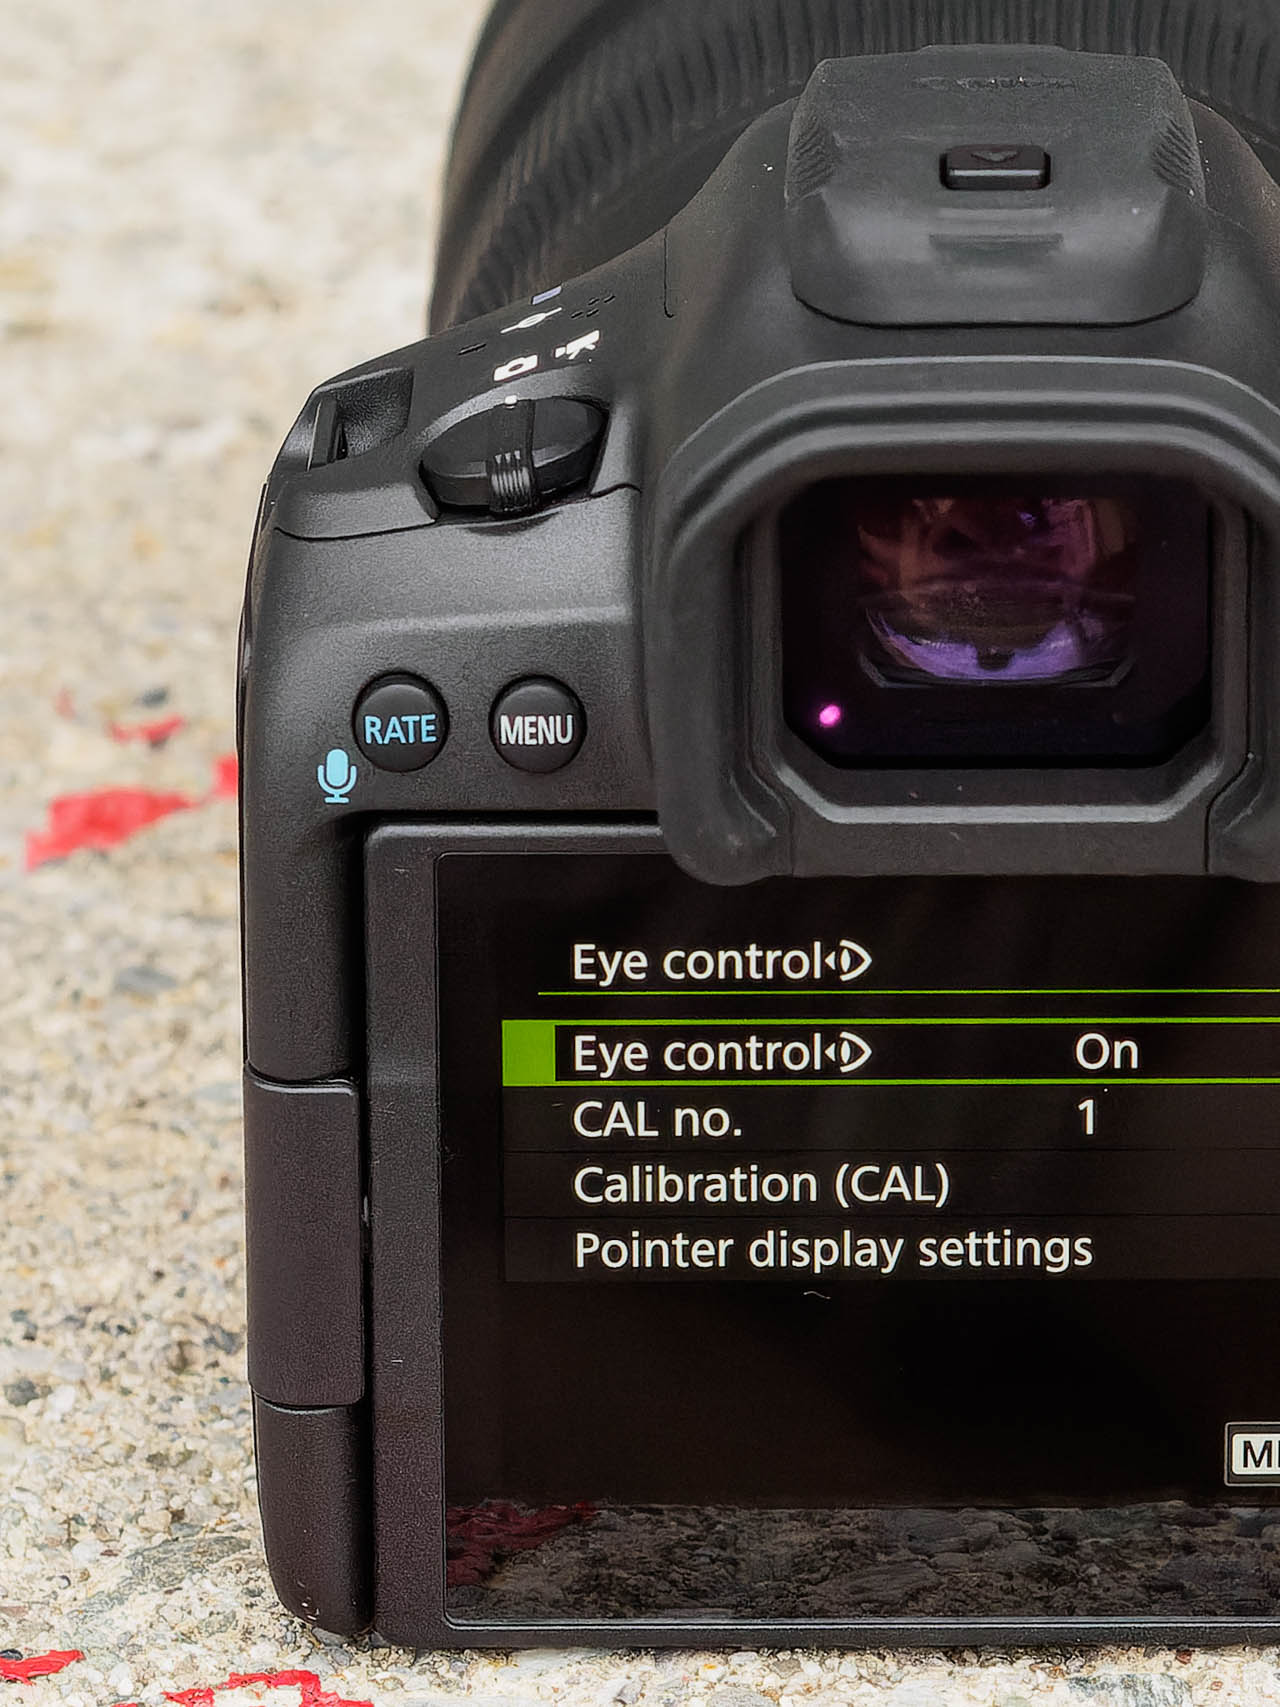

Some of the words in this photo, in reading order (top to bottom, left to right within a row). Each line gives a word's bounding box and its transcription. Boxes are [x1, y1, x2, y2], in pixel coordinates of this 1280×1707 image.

[364, 713, 437, 745] RATE
[500, 714, 573, 745] MENU
[573, 943, 648, 985] Eye
[663, 941, 821, 980] control
[574, 1035, 649, 1077] Eye
[663, 1032, 821, 1071] control
[1075, 1032, 1138, 1070] On
[573, 1100, 659, 1138] CAL
[674, 1107, 742, 1137] no.
[1078, 1099, 1094, 1135] 1
[574, 1164, 817, 1203] Calibration
[835, 1163, 949, 1209] (CAL)
[576, 1230, 734, 1268] Pointer
[749, 1229, 905, 1274] display
[919, 1228, 1093, 1273] settings
